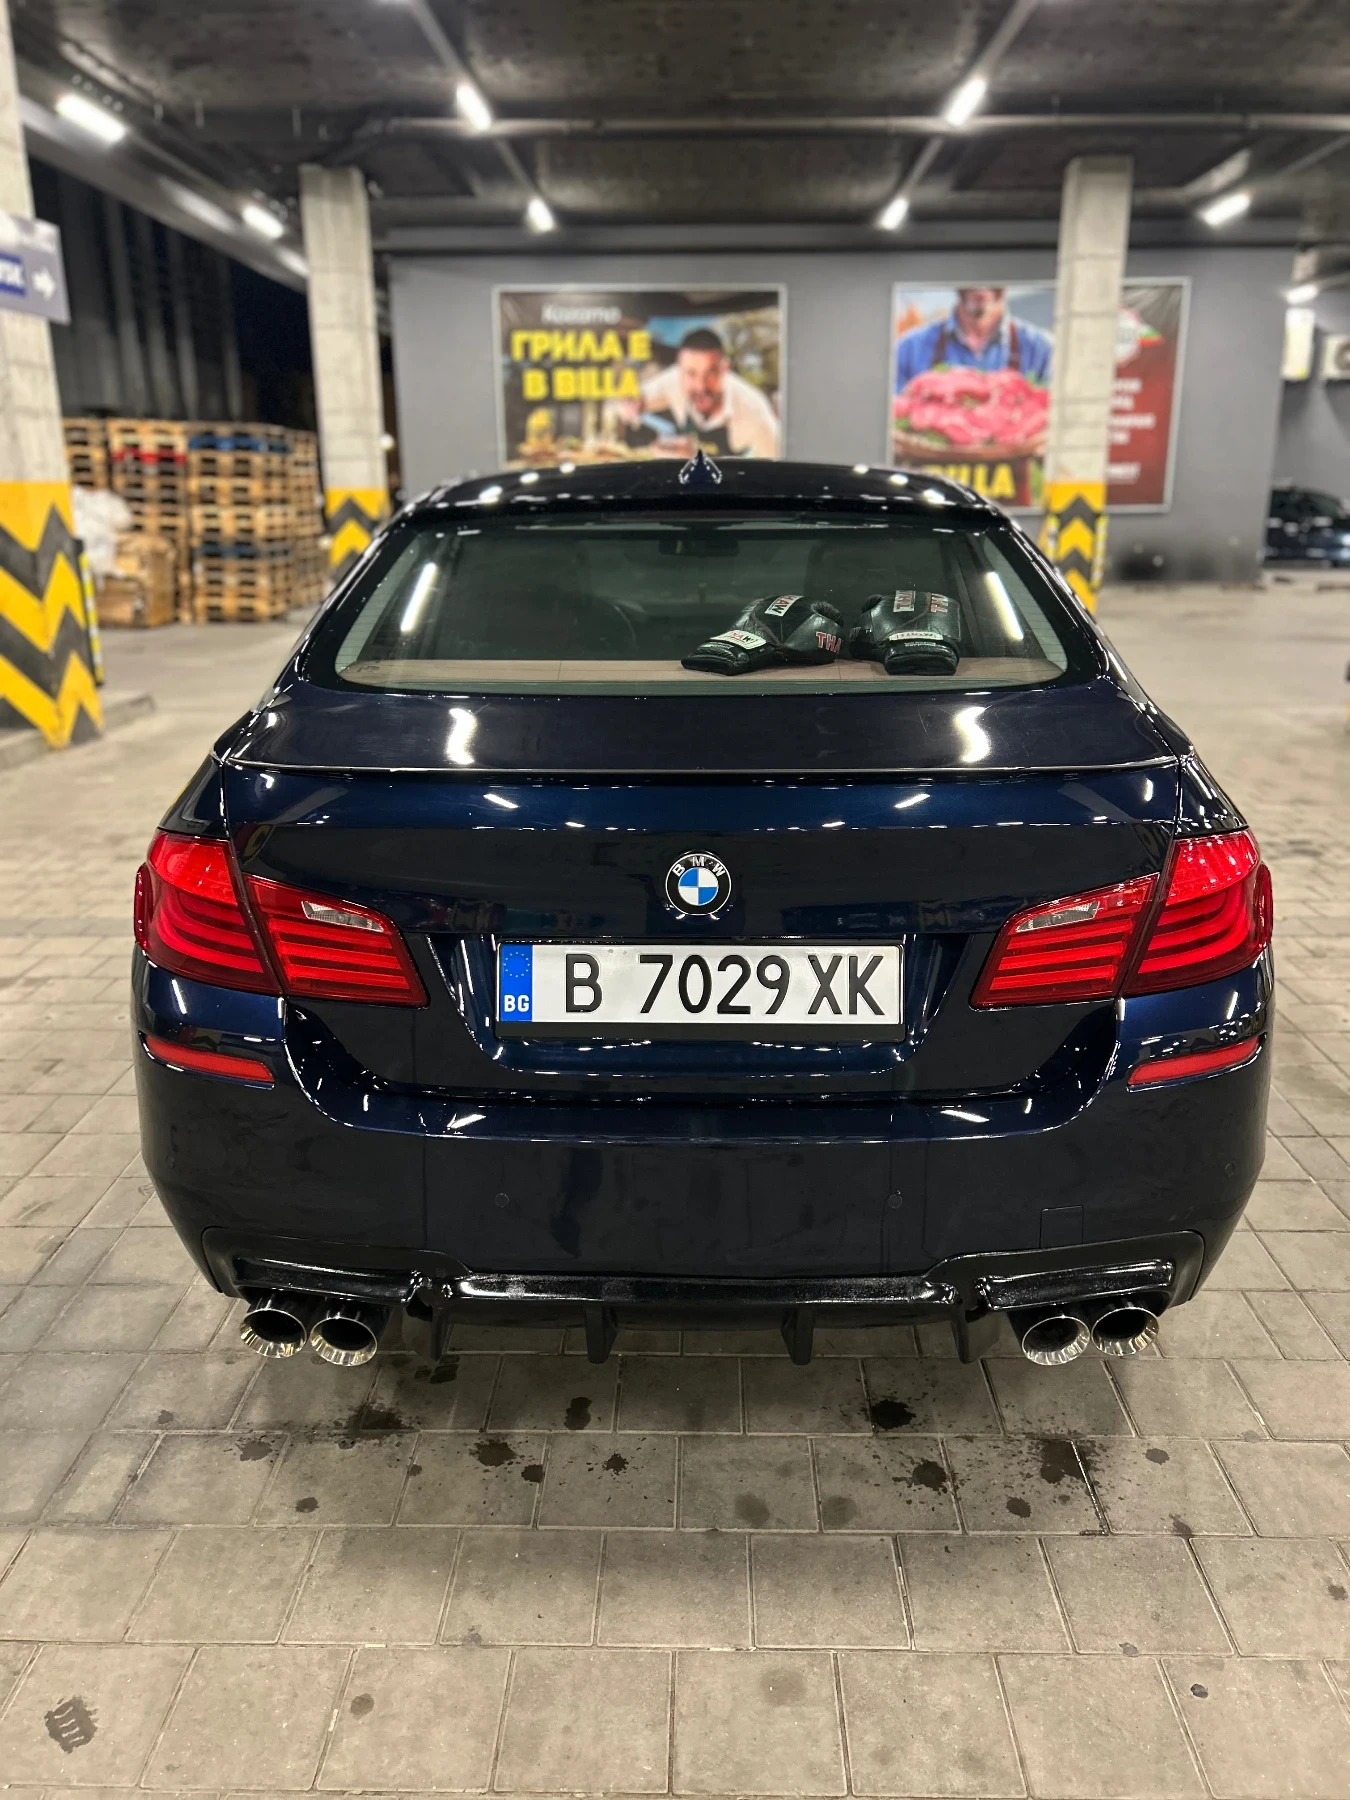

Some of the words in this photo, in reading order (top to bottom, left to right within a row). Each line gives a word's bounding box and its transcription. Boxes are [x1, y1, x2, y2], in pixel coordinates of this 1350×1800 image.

[511, 329, 623, 362] ГРИЛА
[523, 368, 548, 400] В
[553, 366, 640, 399] BILLA
[672, 856, 725, 877] BMW
[565, 953, 603, 1013] B
[639, 954, 790, 1014] 7029
[807, 955, 885, 1015] XK
[503, 994, 530, 1012] BG
